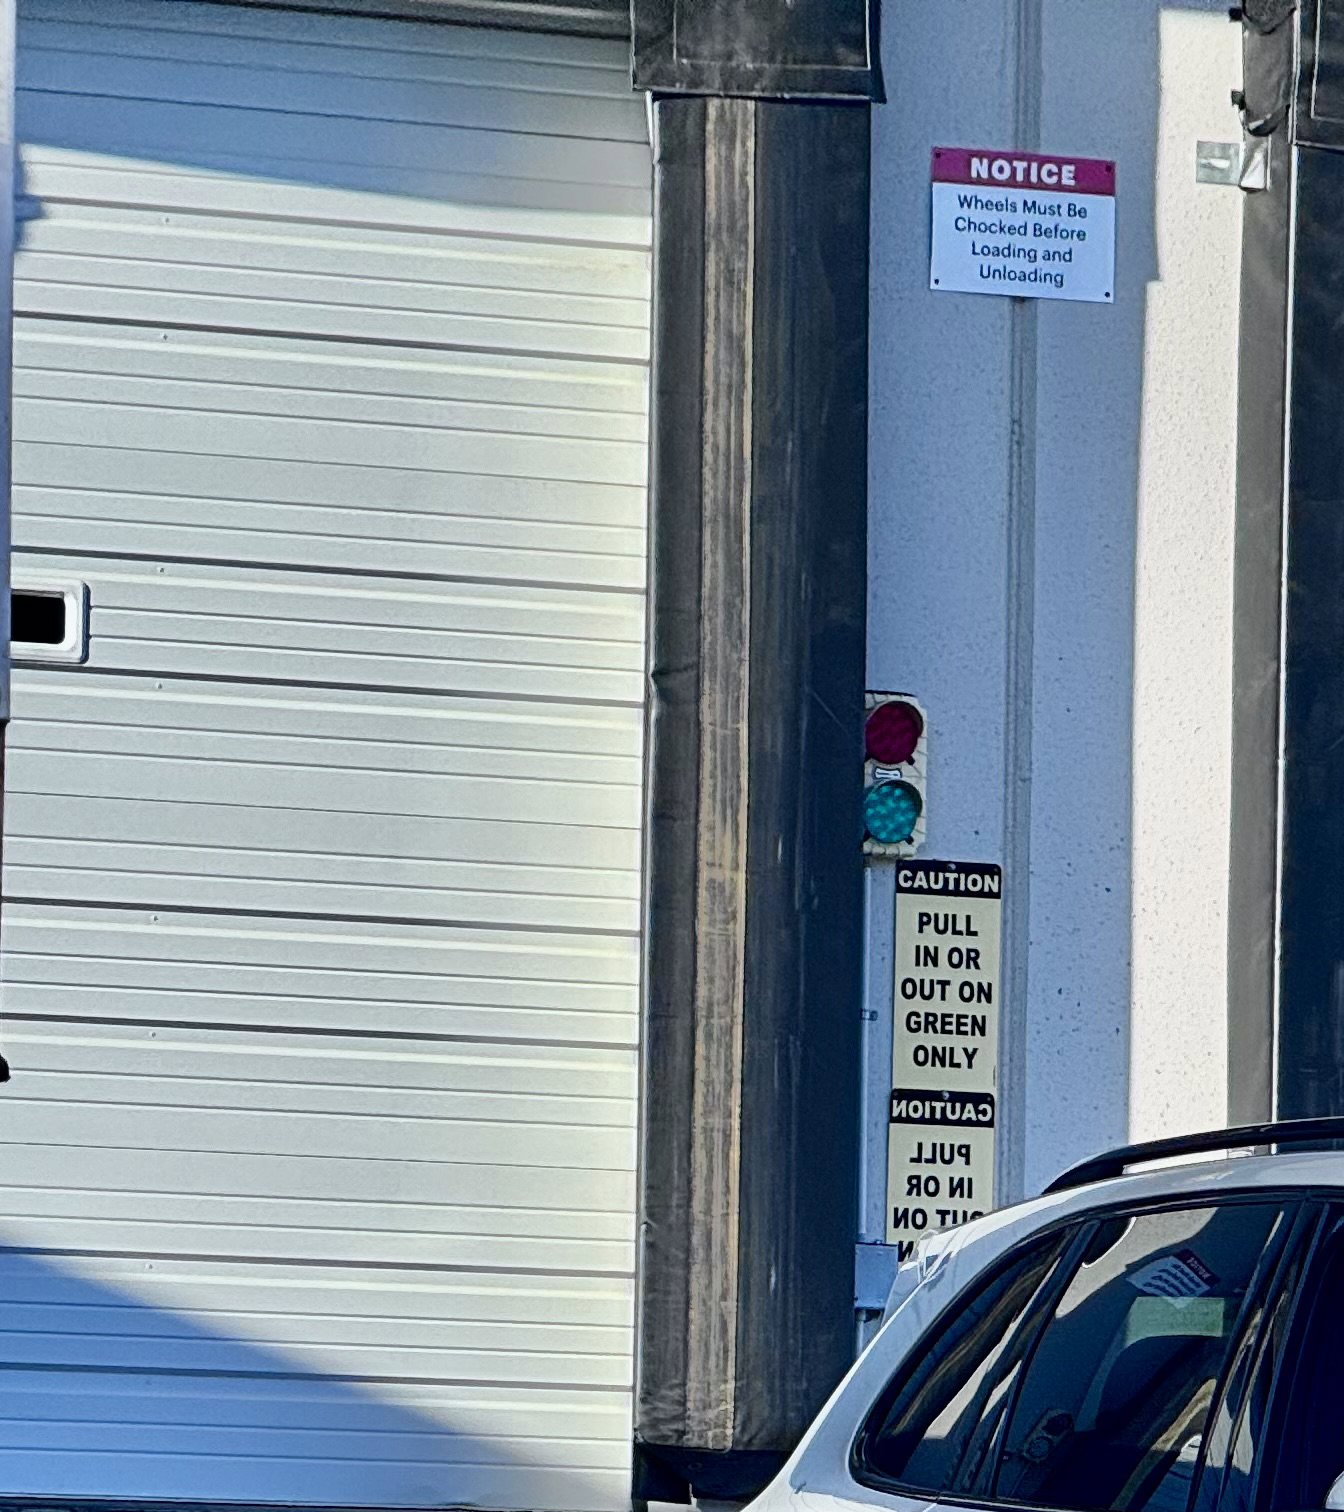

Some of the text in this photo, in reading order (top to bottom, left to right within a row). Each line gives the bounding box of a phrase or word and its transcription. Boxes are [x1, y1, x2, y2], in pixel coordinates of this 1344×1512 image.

[971, 157, 1076, 186] NOTICE
[957, 194, 1088, 219] Wheels Must Be
[954, 216, 1087, 241] Chocked Before
[971, 241, 1073, 263] Loading and
[979, 264, 1065, 288] Unloading
[898, 869, 999, 893] CAUTION
[917, 911, 979, 937] PULL
[914, 944, 981, 970] IN OR
[901, 977, 993, 1004] OUT ON
[905, 1011, 986, 1037] GREEN
[912, 1044, 979, 1070] ONLY
